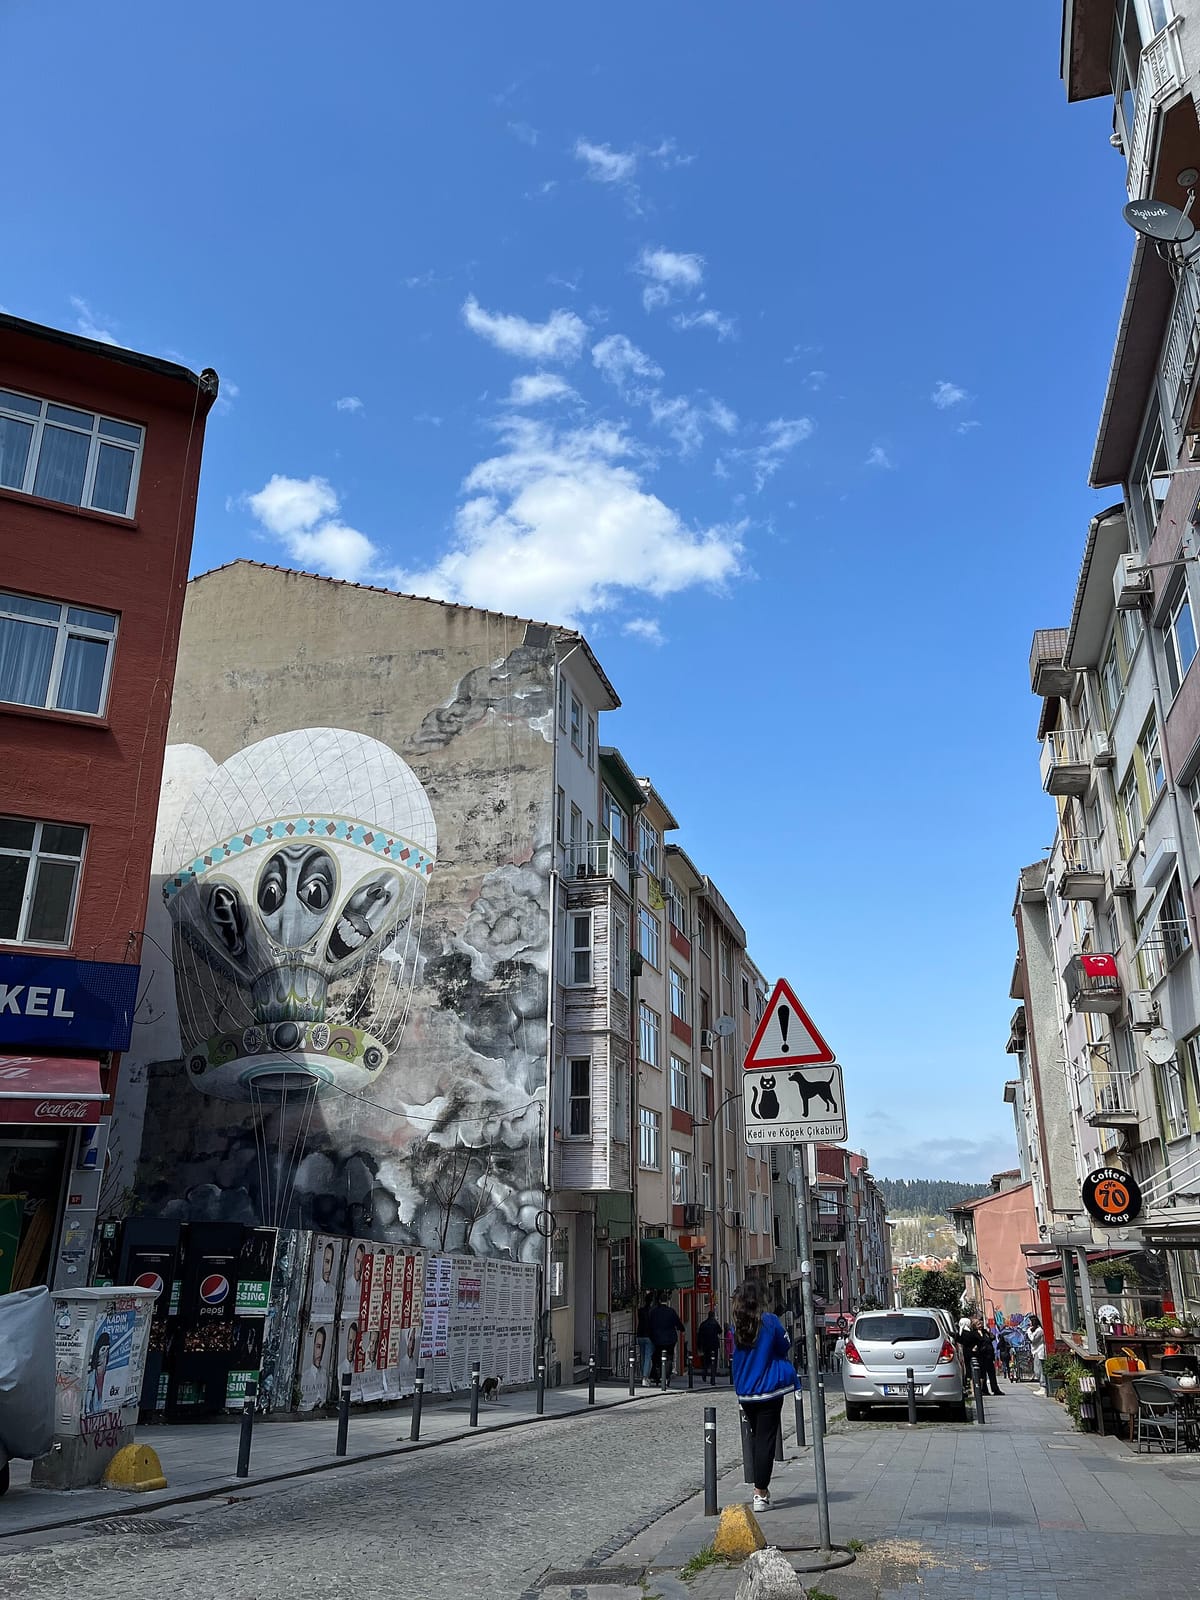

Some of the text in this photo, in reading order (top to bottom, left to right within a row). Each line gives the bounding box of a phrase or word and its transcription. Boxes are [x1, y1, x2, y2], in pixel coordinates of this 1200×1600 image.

[0, 984, 75, 1018] KEL
[35, 1100, 89, 1118] Coca-Cola
[747, 1129, 765, 1139] Kedi
[779, 1127, 805, 1139] Köpek
[806, 1125, 842, 1138] Çıkabilir
[1090, 1169, 1126, 1184] Coffee
[1099, 1189, 1127, 1208] 70
[1104, 1213, 1129, 1222] deep
[243, 1282, 263, 1292] THE
[200, 1306, 225, 1316] pepsi
[231, 1372, 252, 1382] THE
